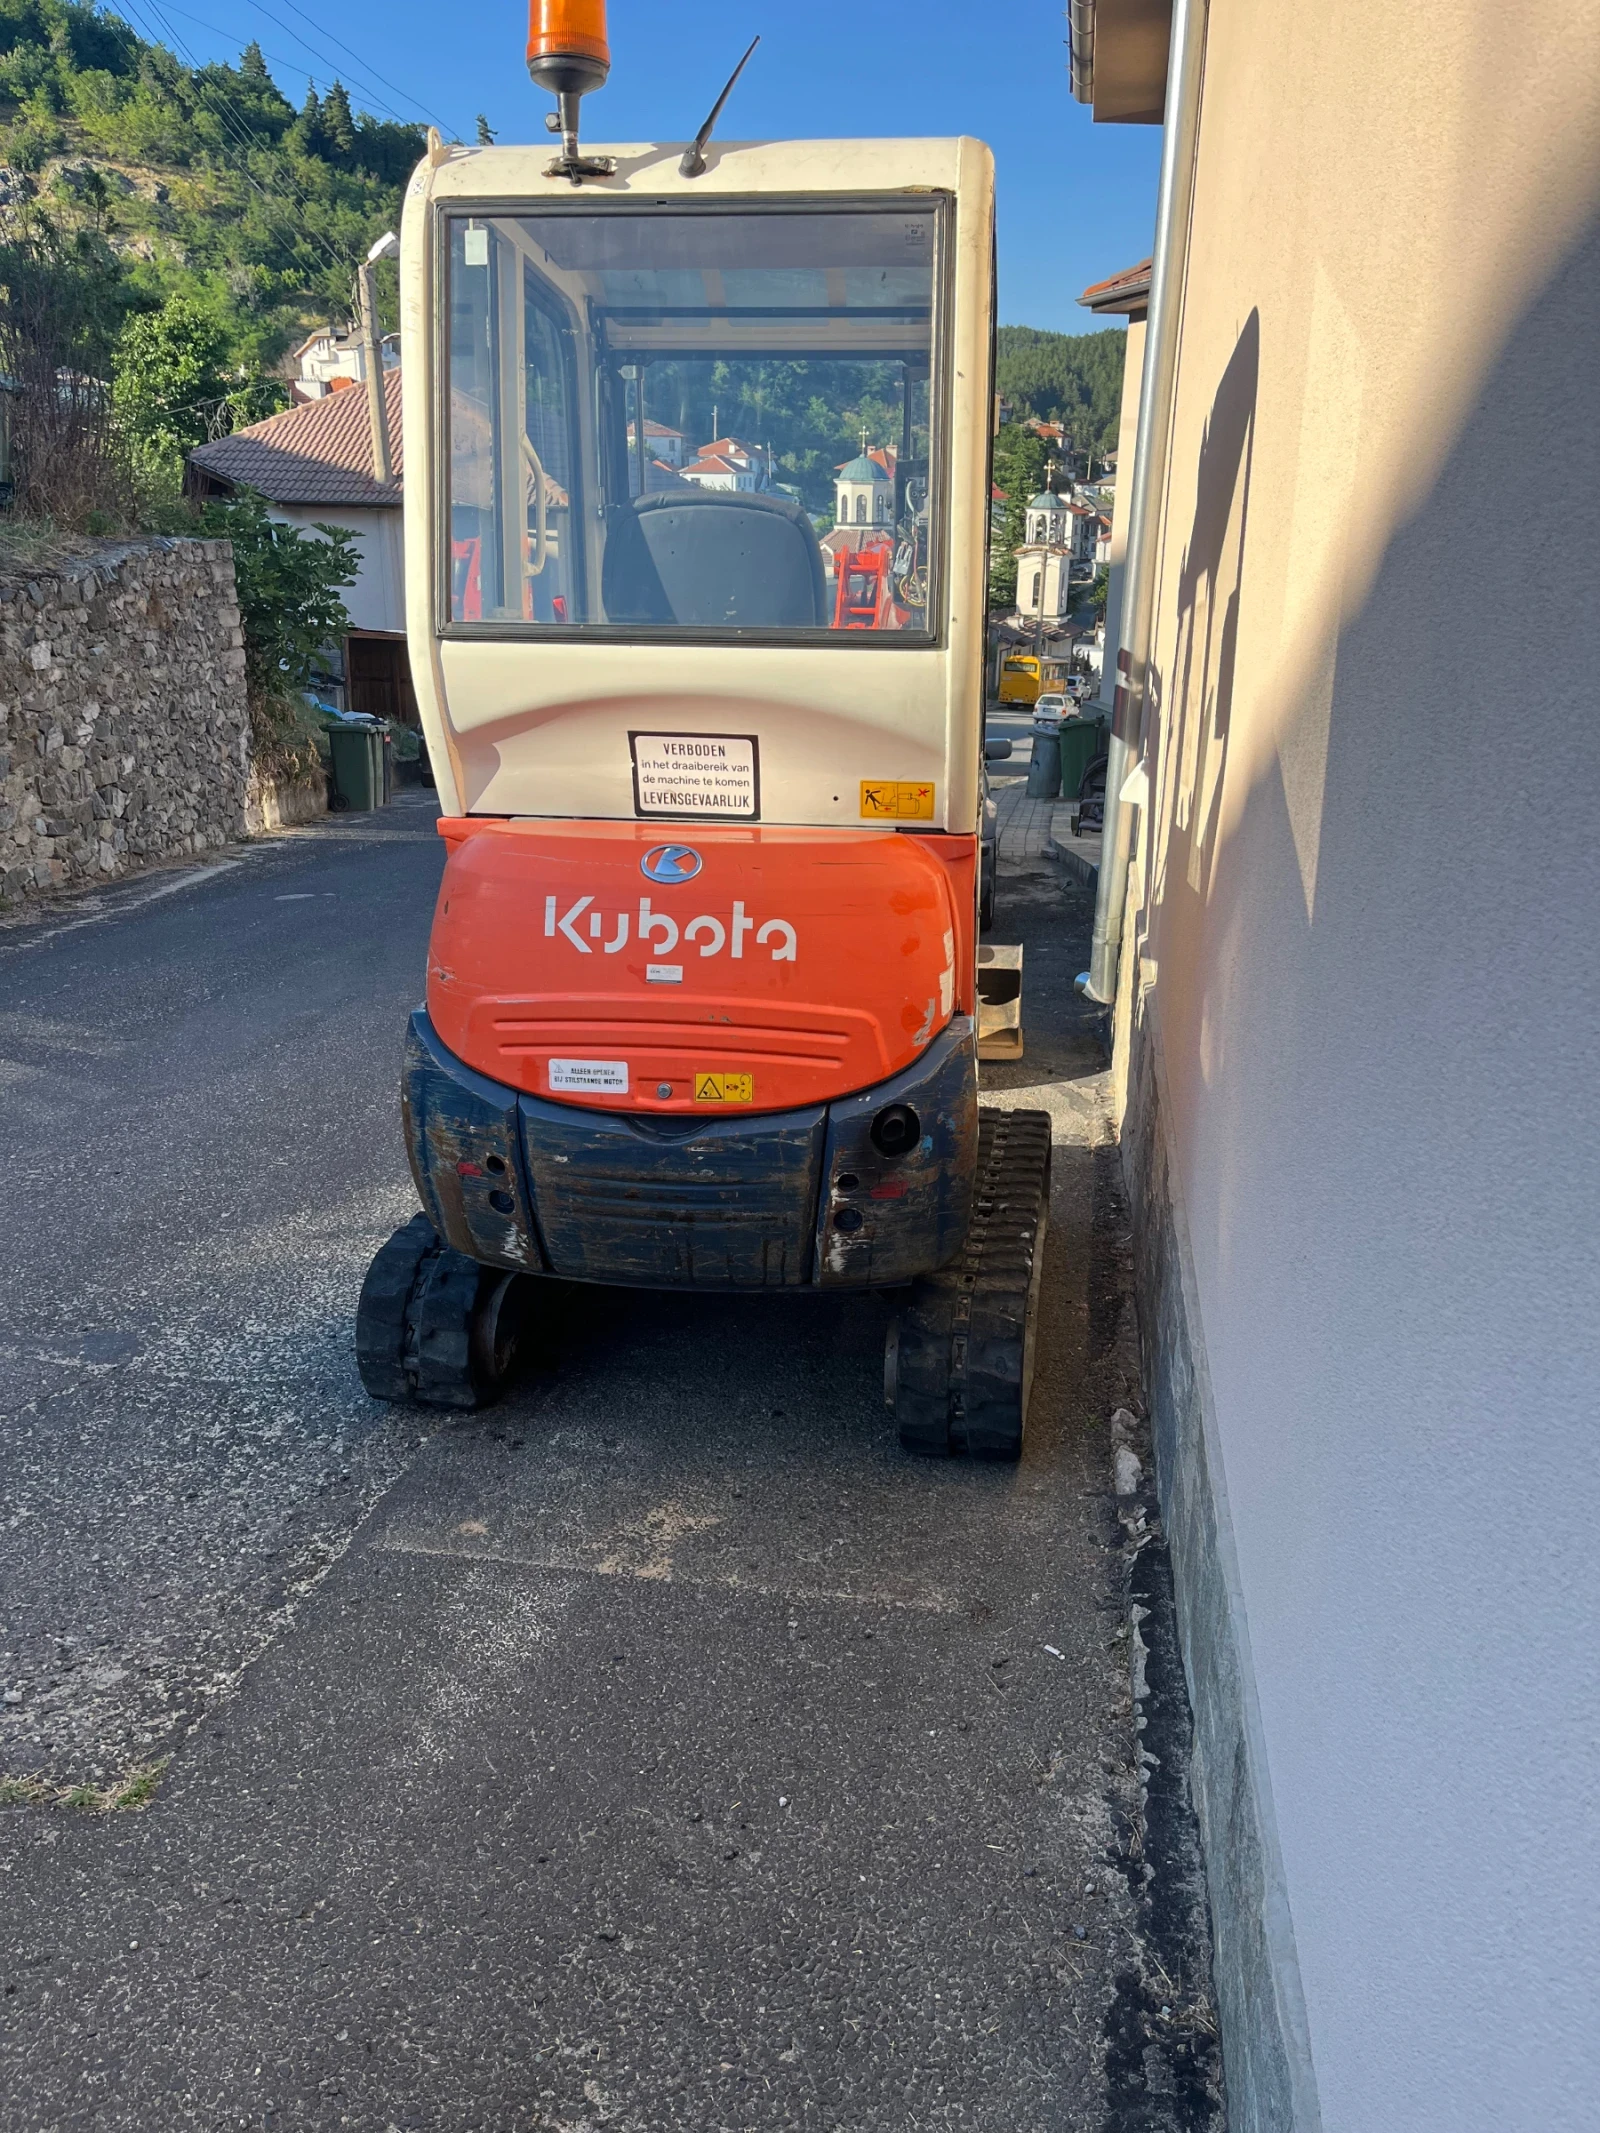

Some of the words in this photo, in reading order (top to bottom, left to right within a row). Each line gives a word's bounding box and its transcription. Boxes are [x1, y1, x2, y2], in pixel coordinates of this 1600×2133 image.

[663, 743, 725, 757] VERBODEN
[642, 760, 651, 768] in
[653, 761, 670, 769] het
[672, 761, 728, 772] draaibereik
[643, 775, 655, 783] de
[658, 776, 700, 785] machine
[715, 777, 749, 787] komen
[644, 791, 750, 807] LEVENSGEVAARLIJK
[544, 895, 798, 961] Kubota
